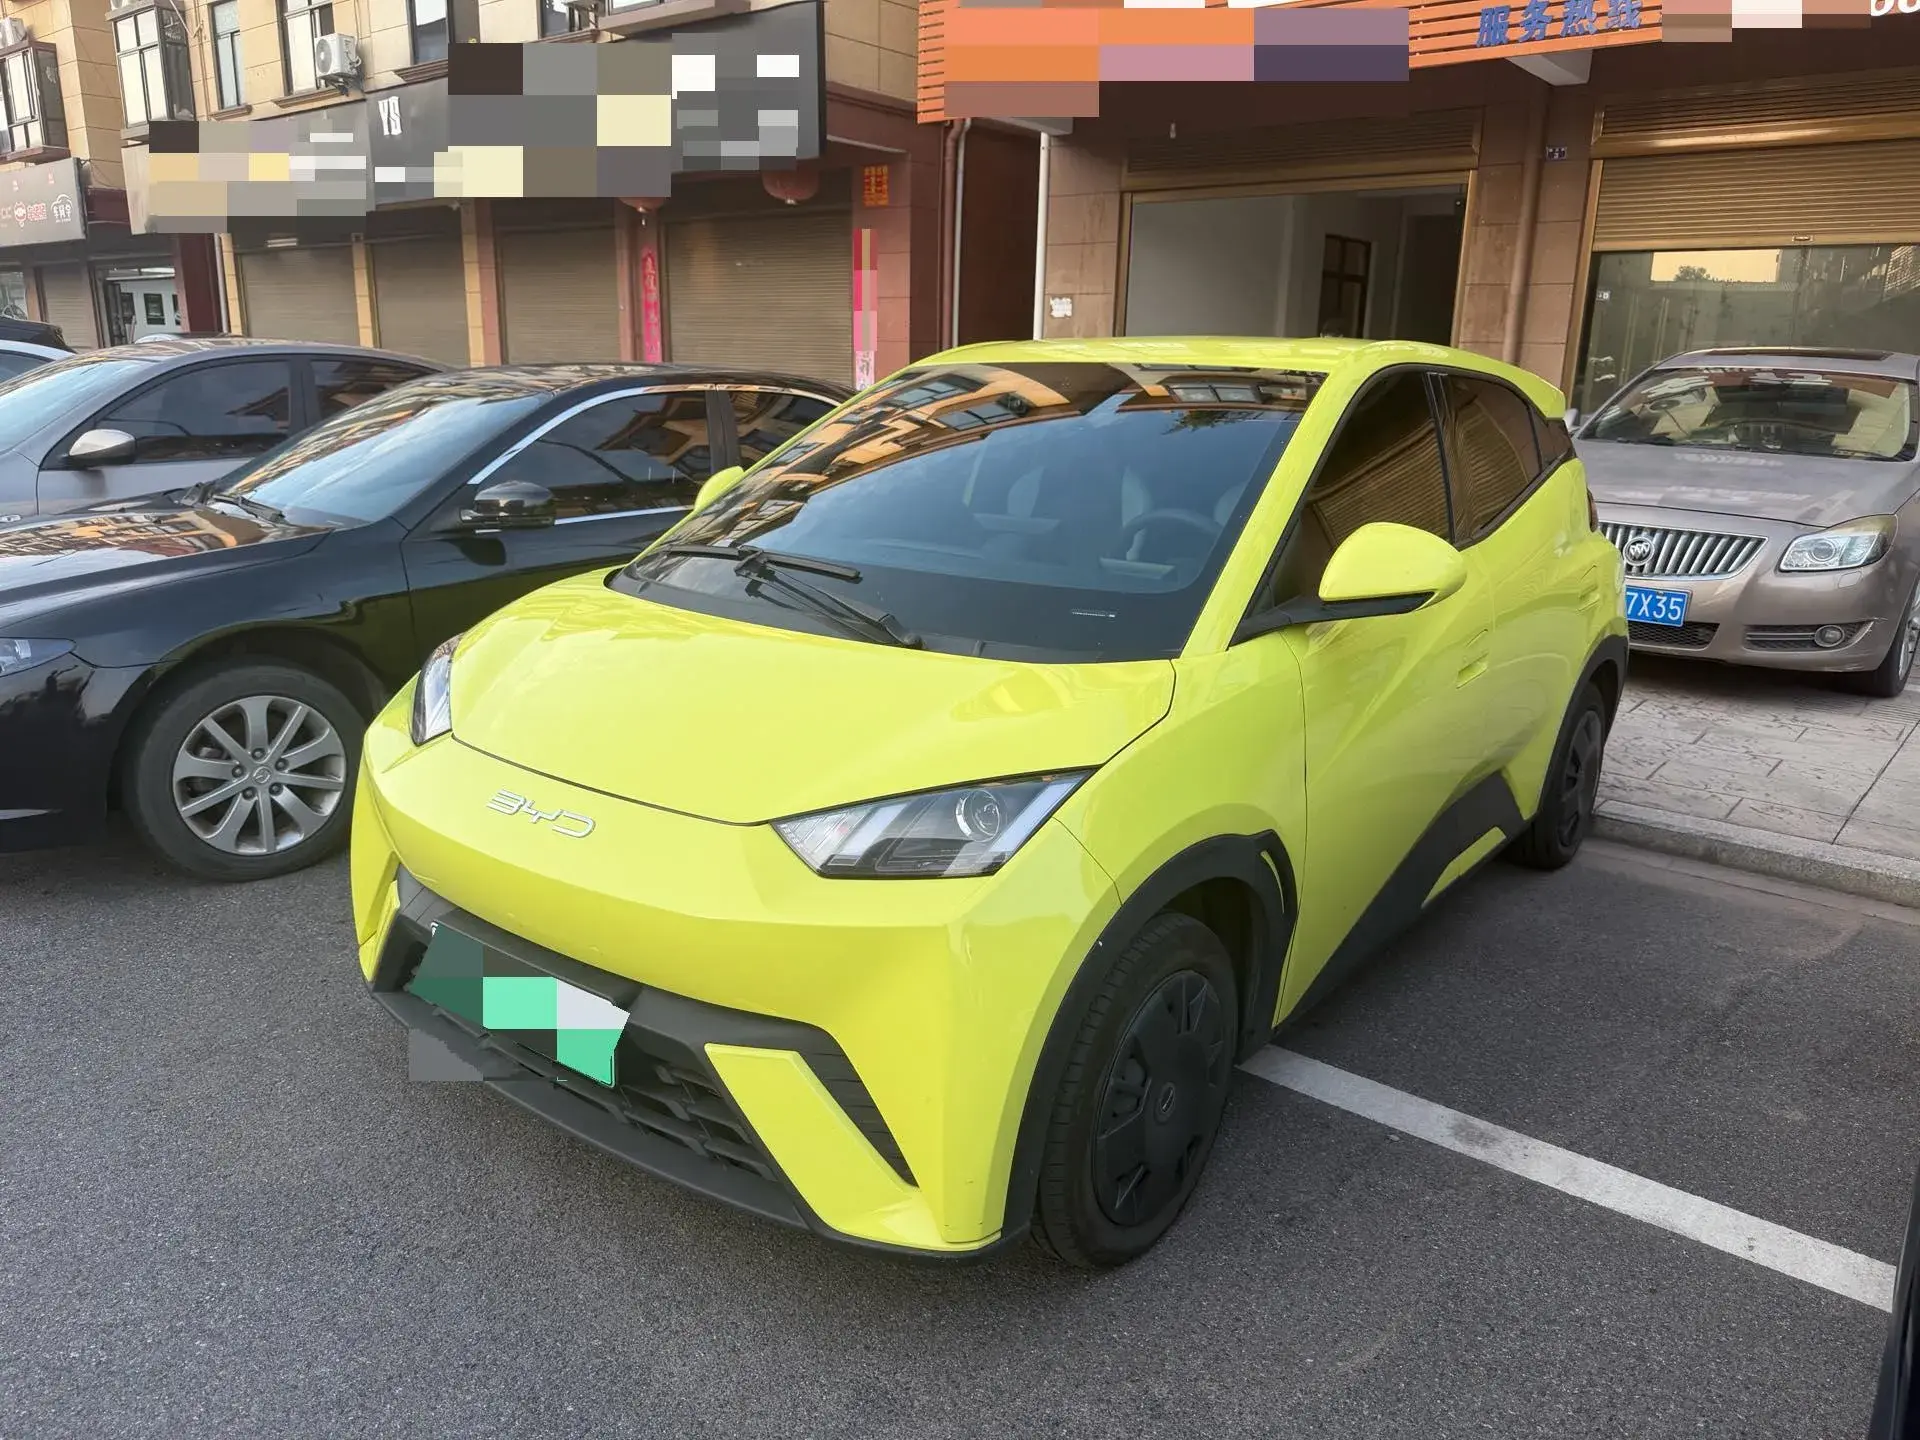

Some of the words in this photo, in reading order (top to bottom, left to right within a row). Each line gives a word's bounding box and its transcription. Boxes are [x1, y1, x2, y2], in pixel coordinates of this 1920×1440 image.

[1476, 0, 1643, 48] 服务热线
[378, 95, 402, 136] YS
[1626, 591, 1684, 620] 7X35
[485, 788, 596, 838] BYD
